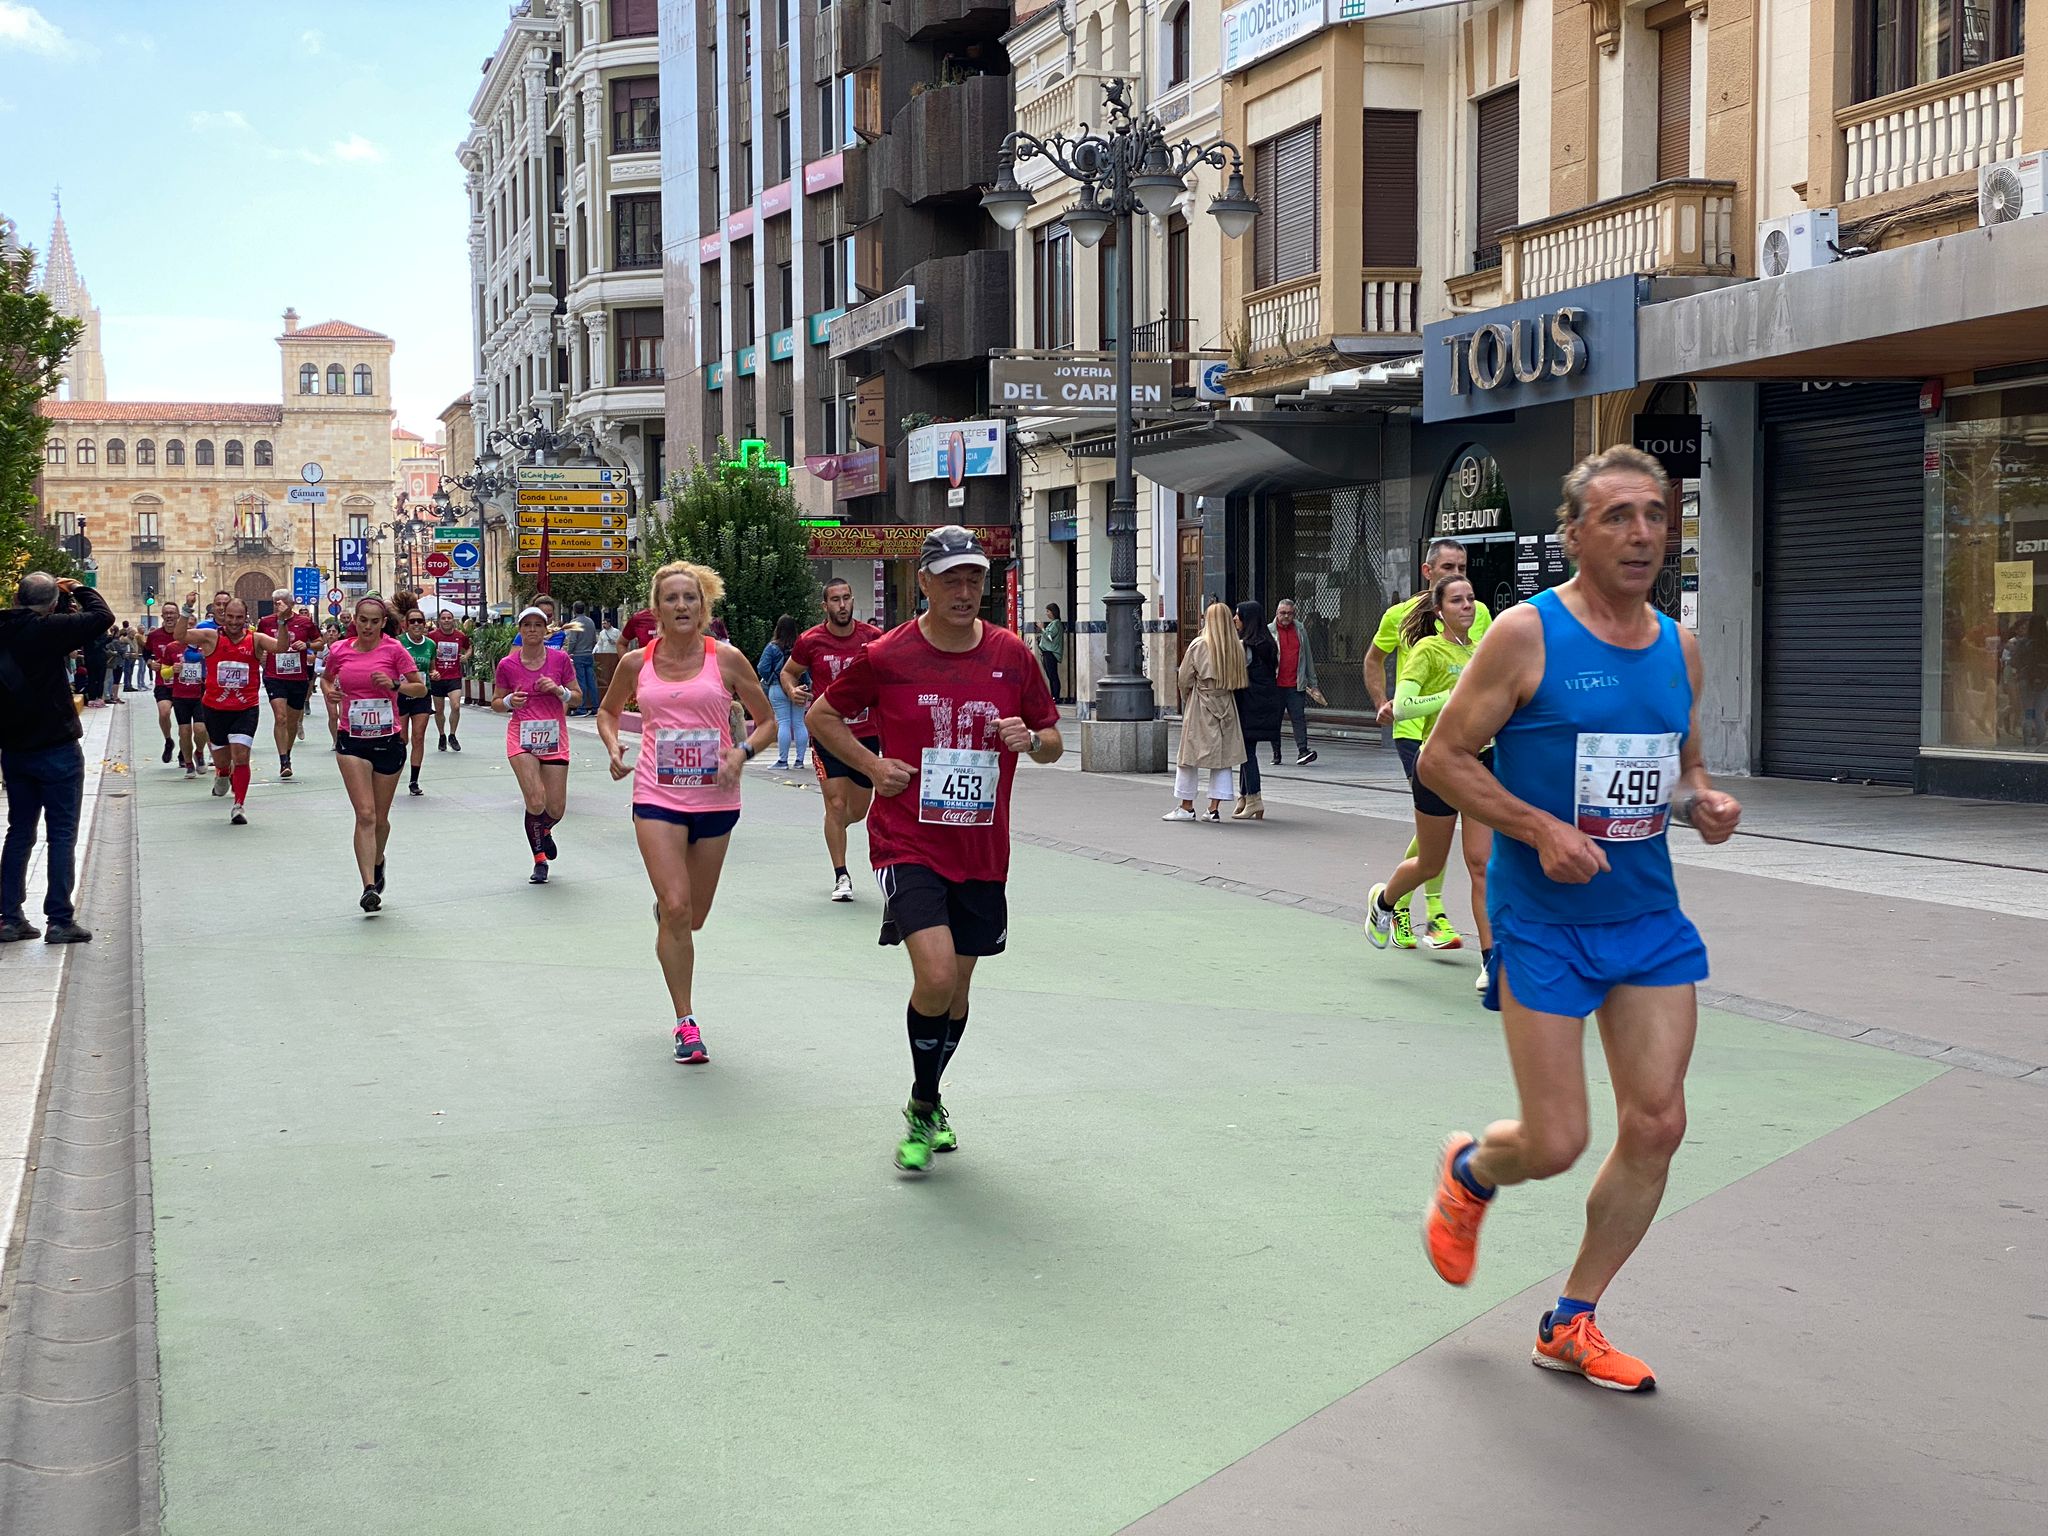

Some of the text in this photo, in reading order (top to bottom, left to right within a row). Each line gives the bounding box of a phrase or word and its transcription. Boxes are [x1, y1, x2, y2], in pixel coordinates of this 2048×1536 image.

[1441, 306, 1588, 396] TOUS
[1054, 366, 1112, 378] JOYERIA
[1004, 383, 1048, 400] DEL
[1640, 439, 1697, 454] TOUS
[1462, 468, 1477, 487] BE
[520, 491, 568, 501] Conde Luna
[554, 515, 573, 524] León
[1441, 508, 1501, 531] BE BEAUTY
[811, 527, 876, 539] ROYAL
[342, 539, 356, 561] P
[577, 560, 597, 568] Luna
[282, 660, 295, 668] 469
[184, 670, 197, 678] 539
[225, 670, 241, 680] 270
[1565, 675, 1620, 691] VITALIS
[361, 711, 380, 725] 701
[531, 731, 550, 744] 672
[674, 748, 702, 768] 361
[941, 775, 982, 801] 453
[1607, 770, 1661, 806] 499
